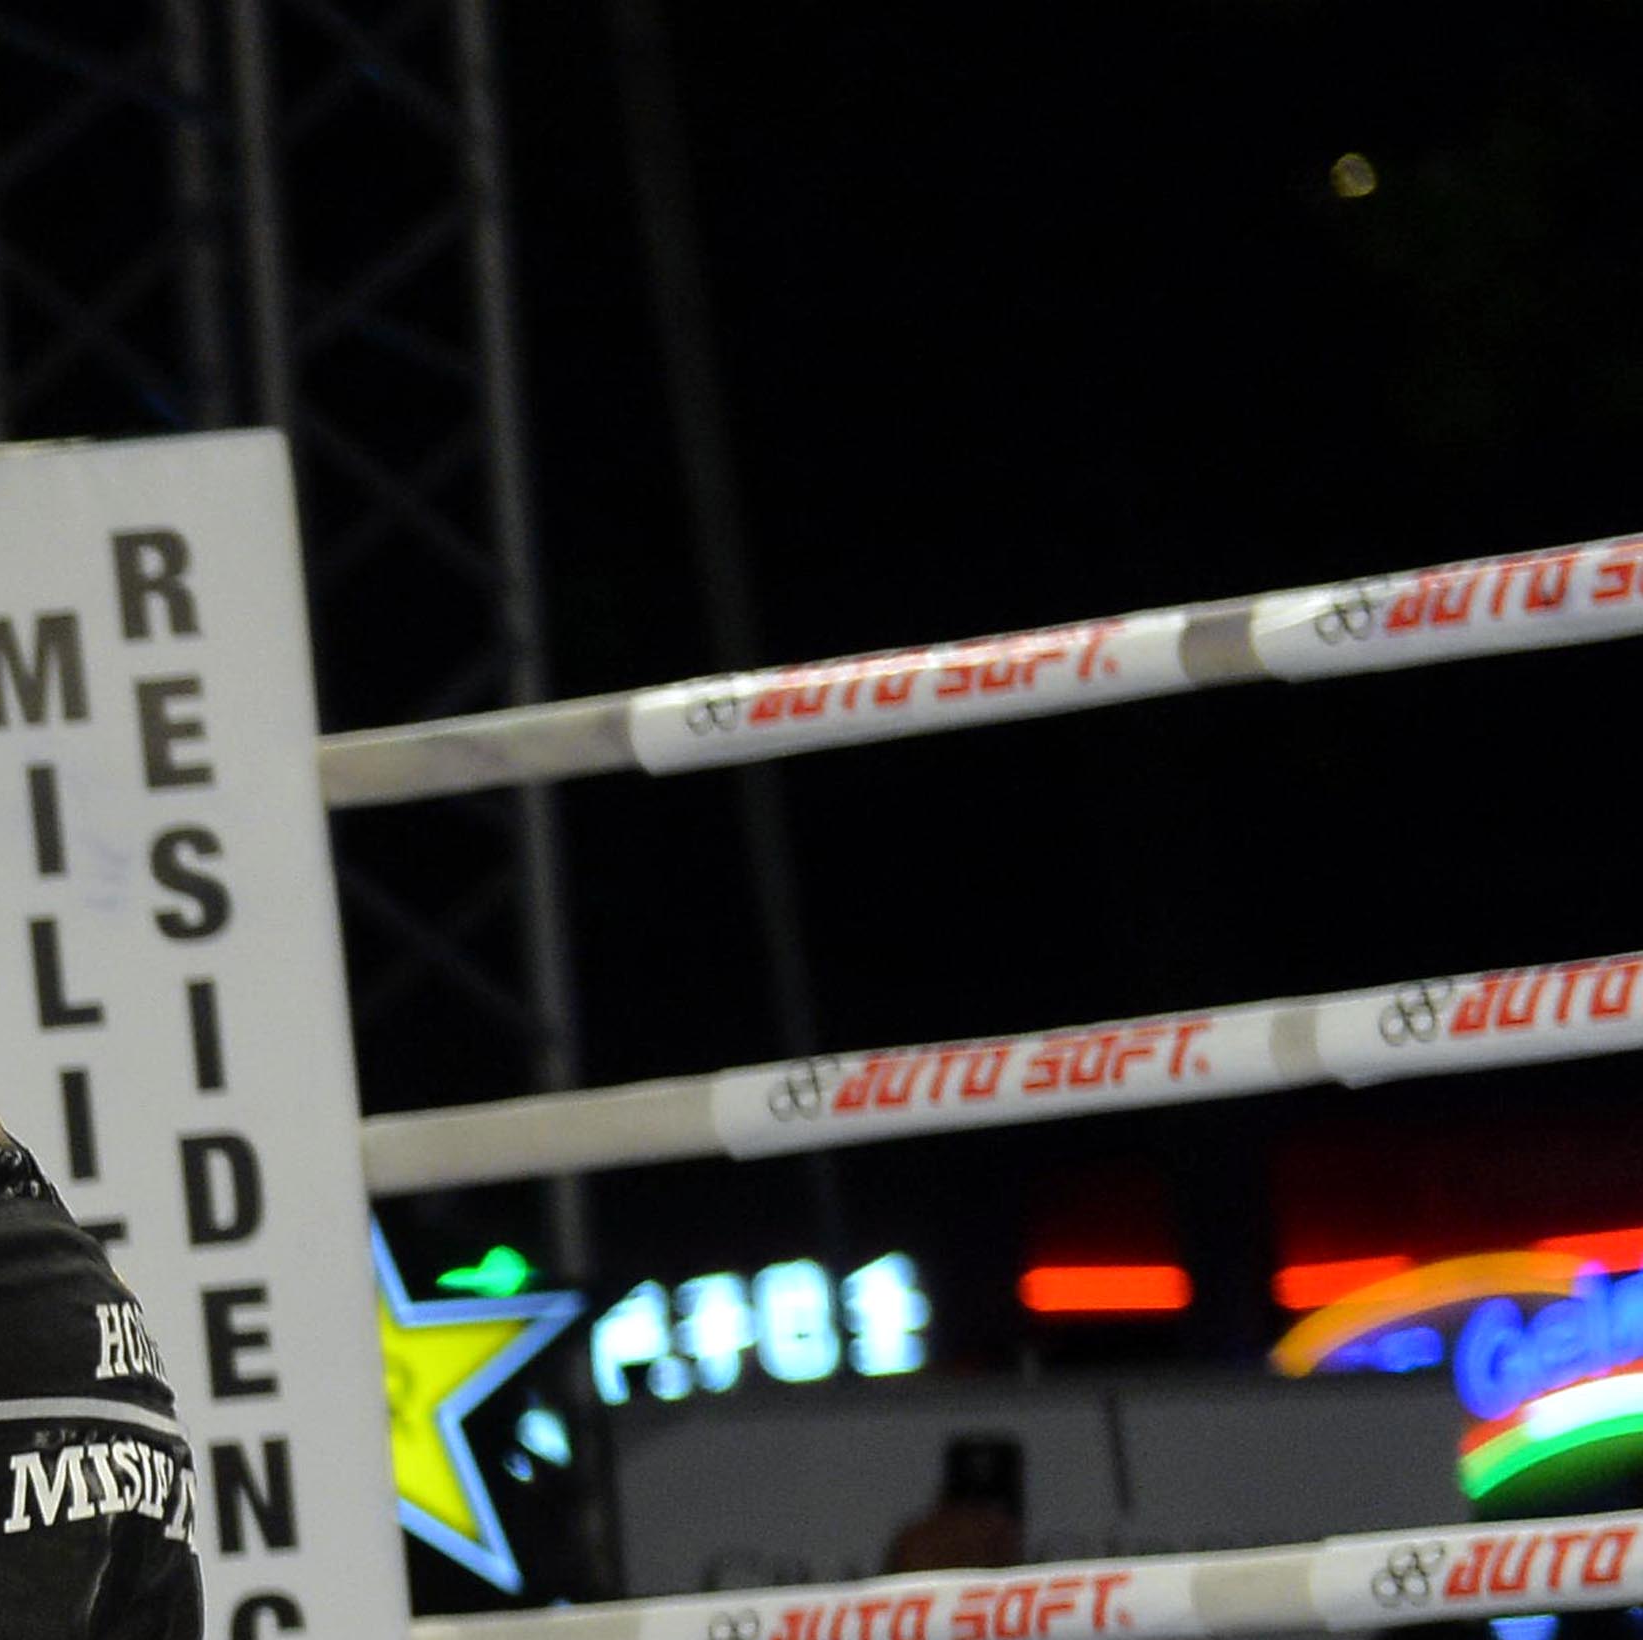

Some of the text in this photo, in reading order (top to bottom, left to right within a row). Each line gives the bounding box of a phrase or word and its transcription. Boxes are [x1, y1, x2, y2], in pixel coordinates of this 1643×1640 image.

[834, 1019, 1211, 1113] AUTO SOFT
[1444, 1527, 1638, 1602] AUTO
